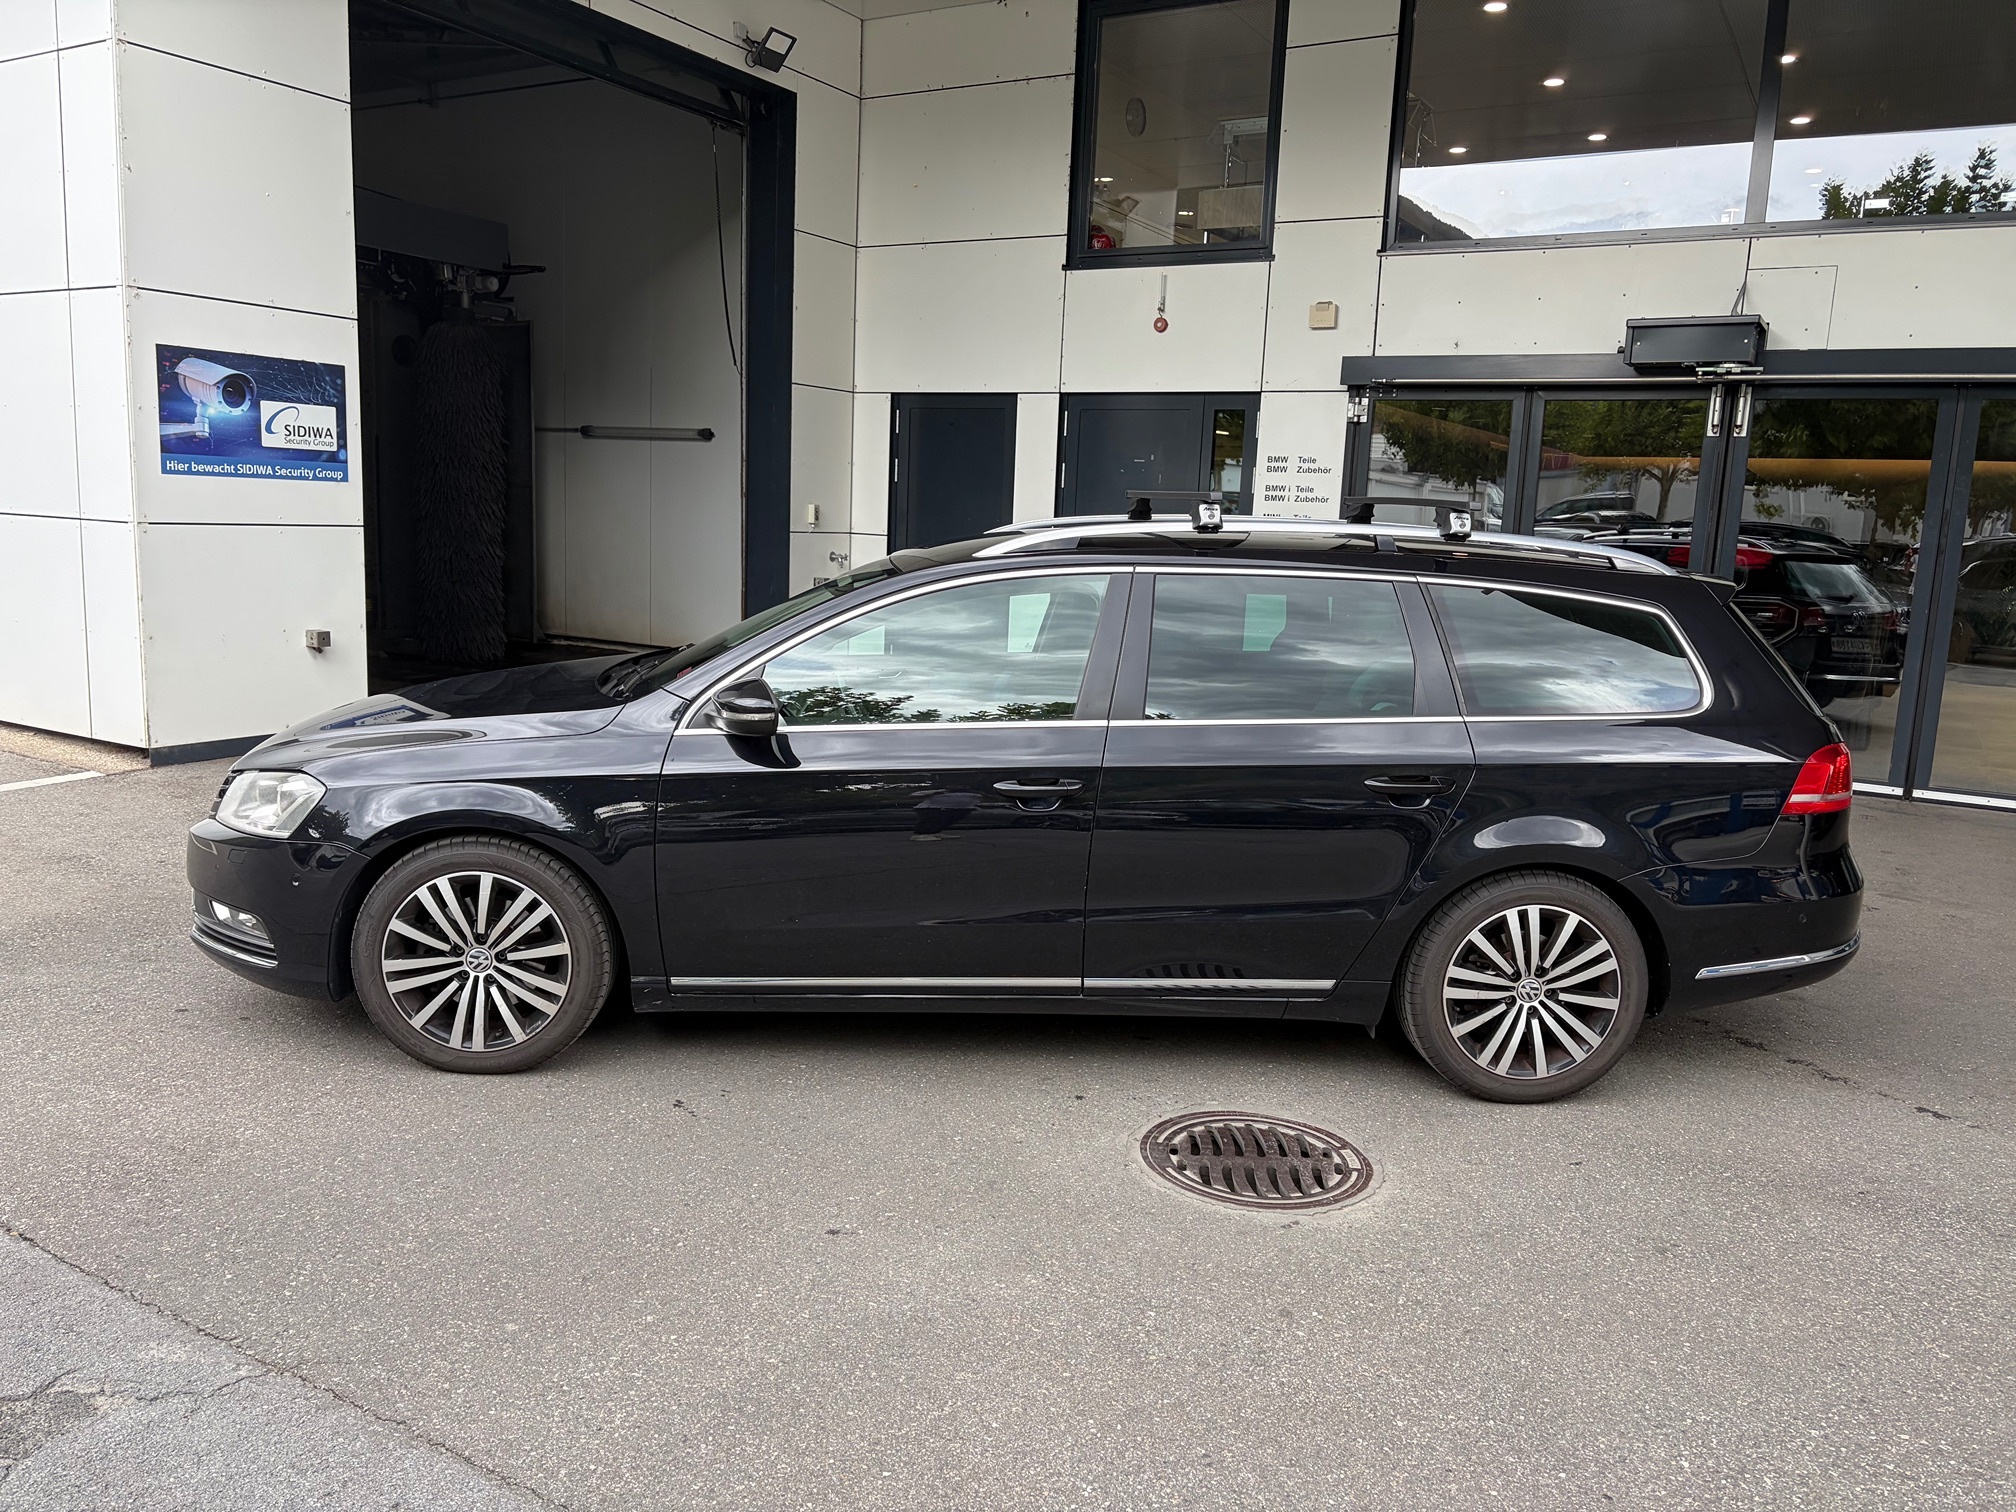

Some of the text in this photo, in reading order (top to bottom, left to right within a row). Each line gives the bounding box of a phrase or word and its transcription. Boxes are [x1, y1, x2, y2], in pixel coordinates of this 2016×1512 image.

[284, 424, 334, 439] SIDIWA
[284, 437, 335, 448] Security Group
[1298, 456, 1317, 464] Teile
[166, 460, 343, 480] Hier bewacht SIDIWA Security Group
[1266, 465, 1332, 474] BMW Zubehör
[1295, 485, 1315, 493] Teile
[1264, 494, 1286, 502] BMW
[1294, 495, 1330, 503] Zubehör
